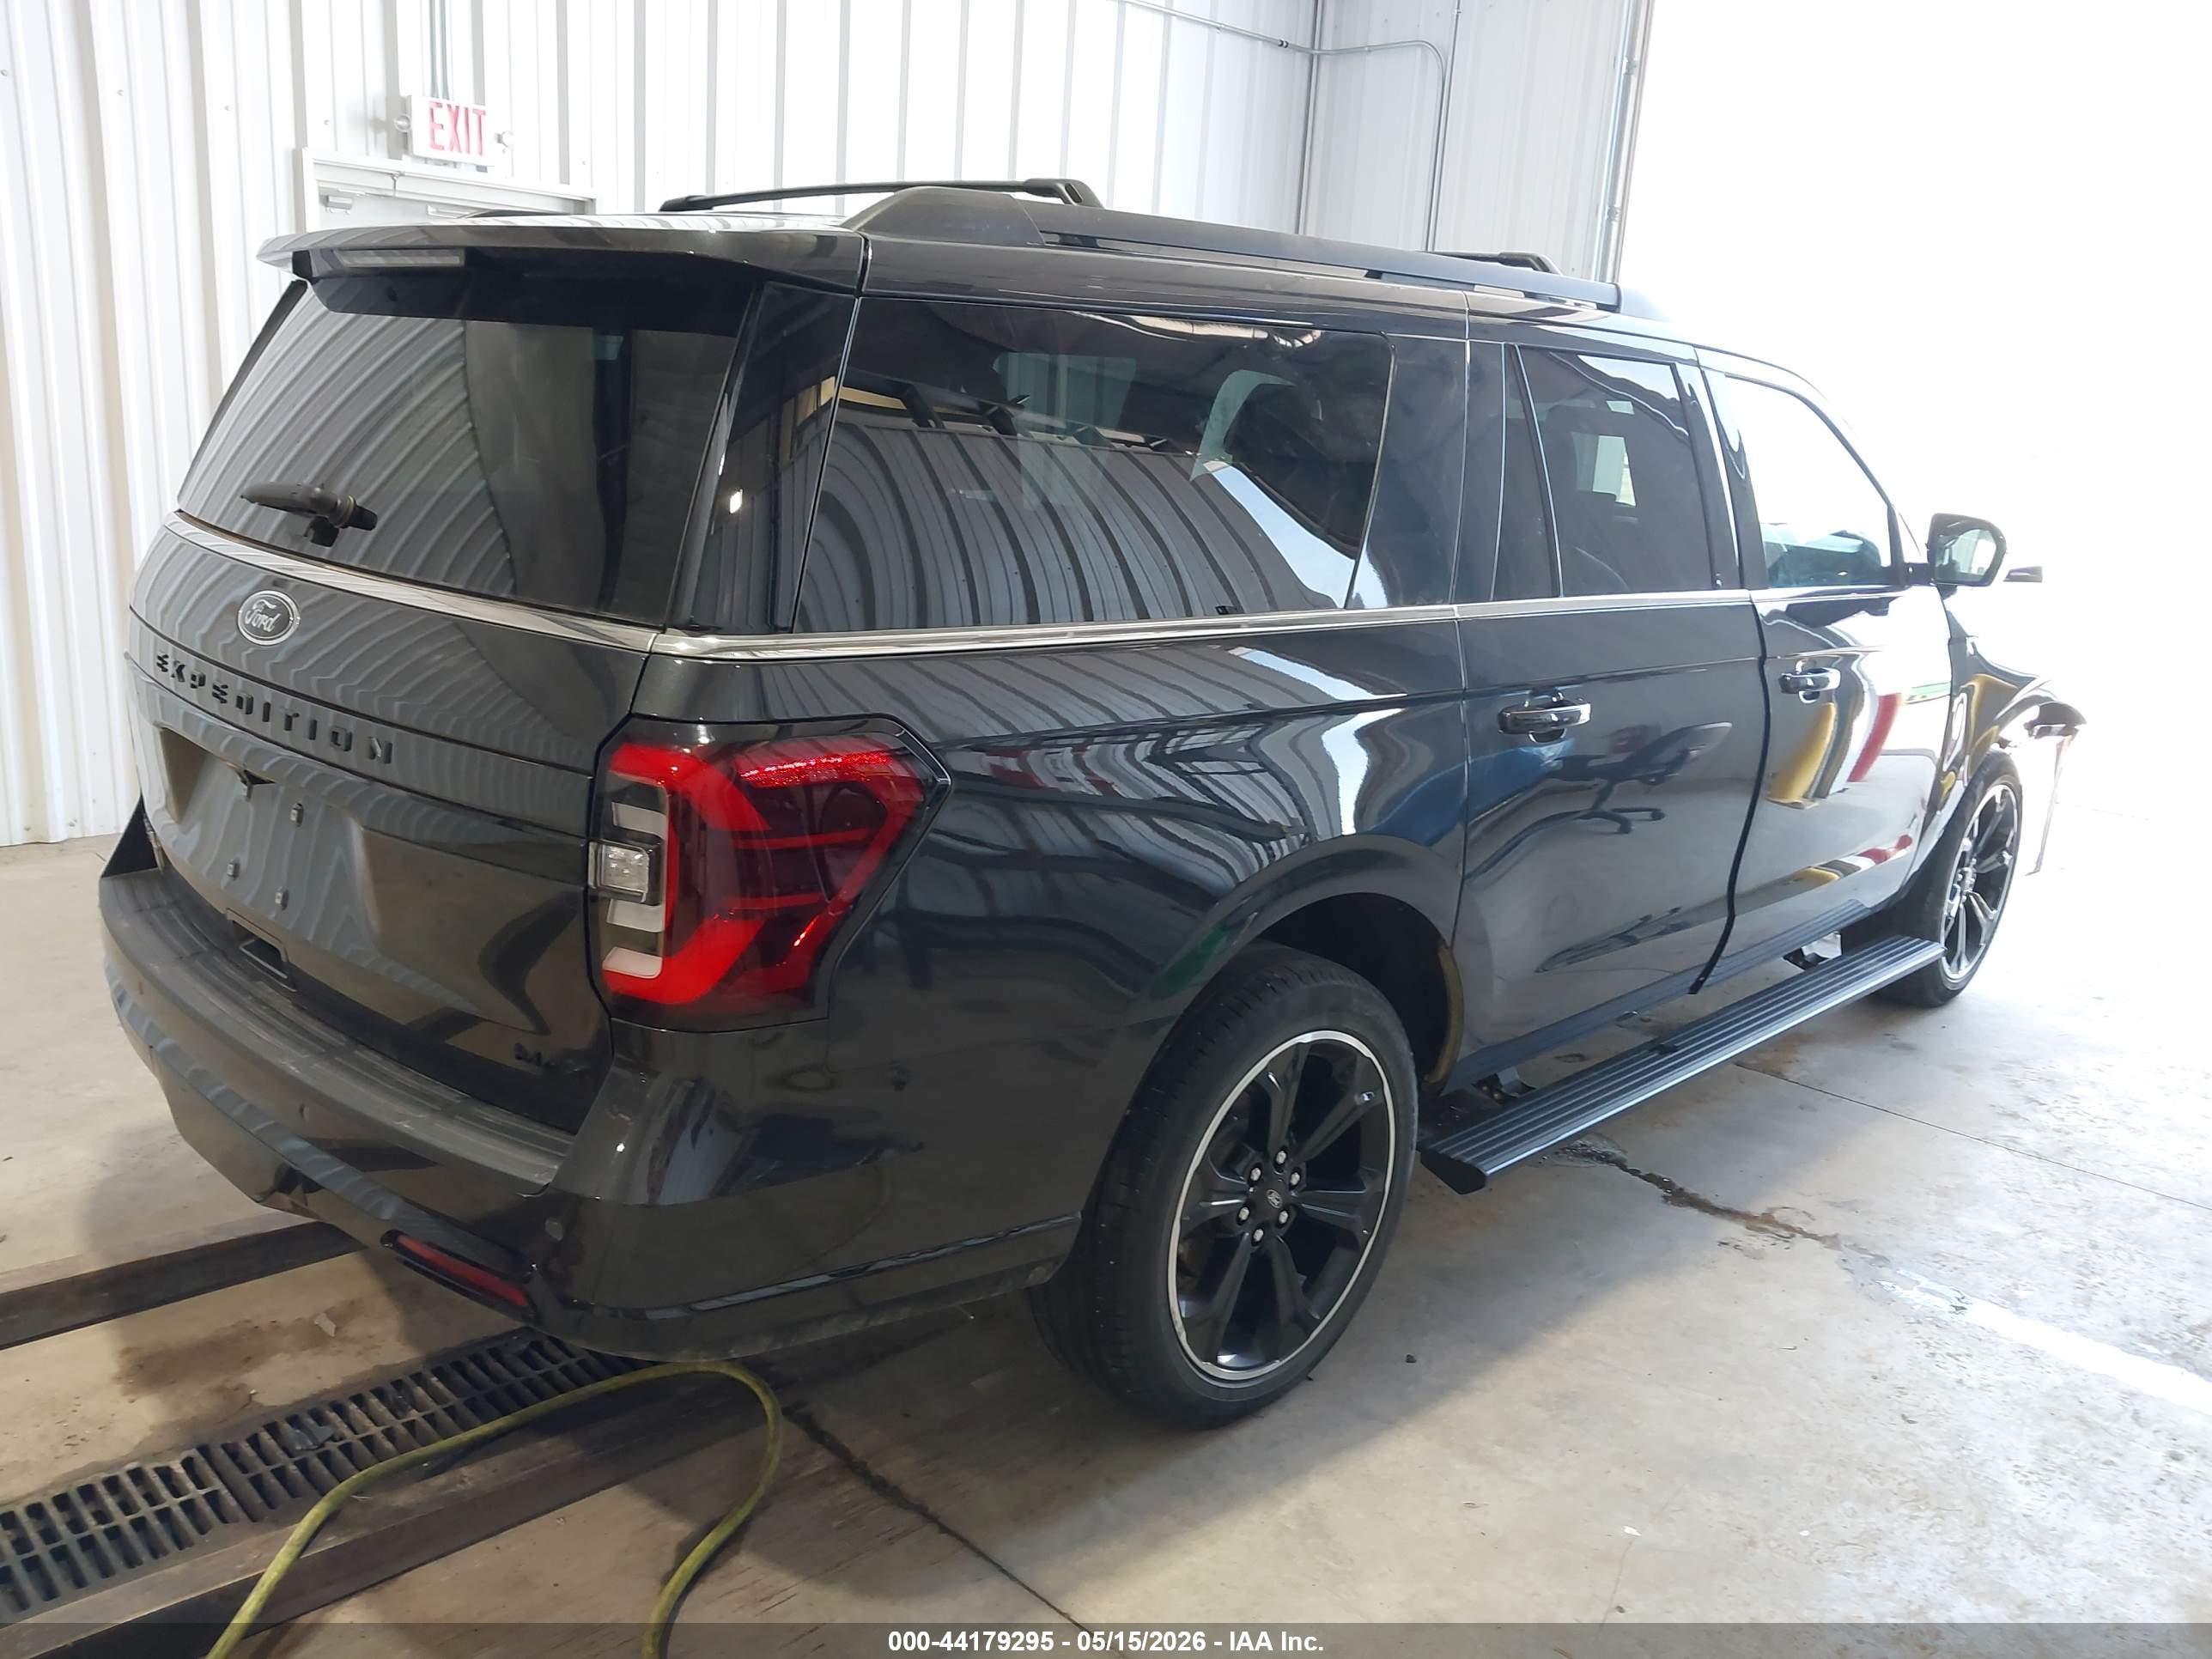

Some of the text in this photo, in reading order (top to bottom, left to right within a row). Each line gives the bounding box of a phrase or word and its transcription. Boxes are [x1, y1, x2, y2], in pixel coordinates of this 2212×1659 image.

[428, 100, 486, 156] EXIT
[245, 599, 282, 633] Ford
[156, 653, 393, 764] EXPEDITION
